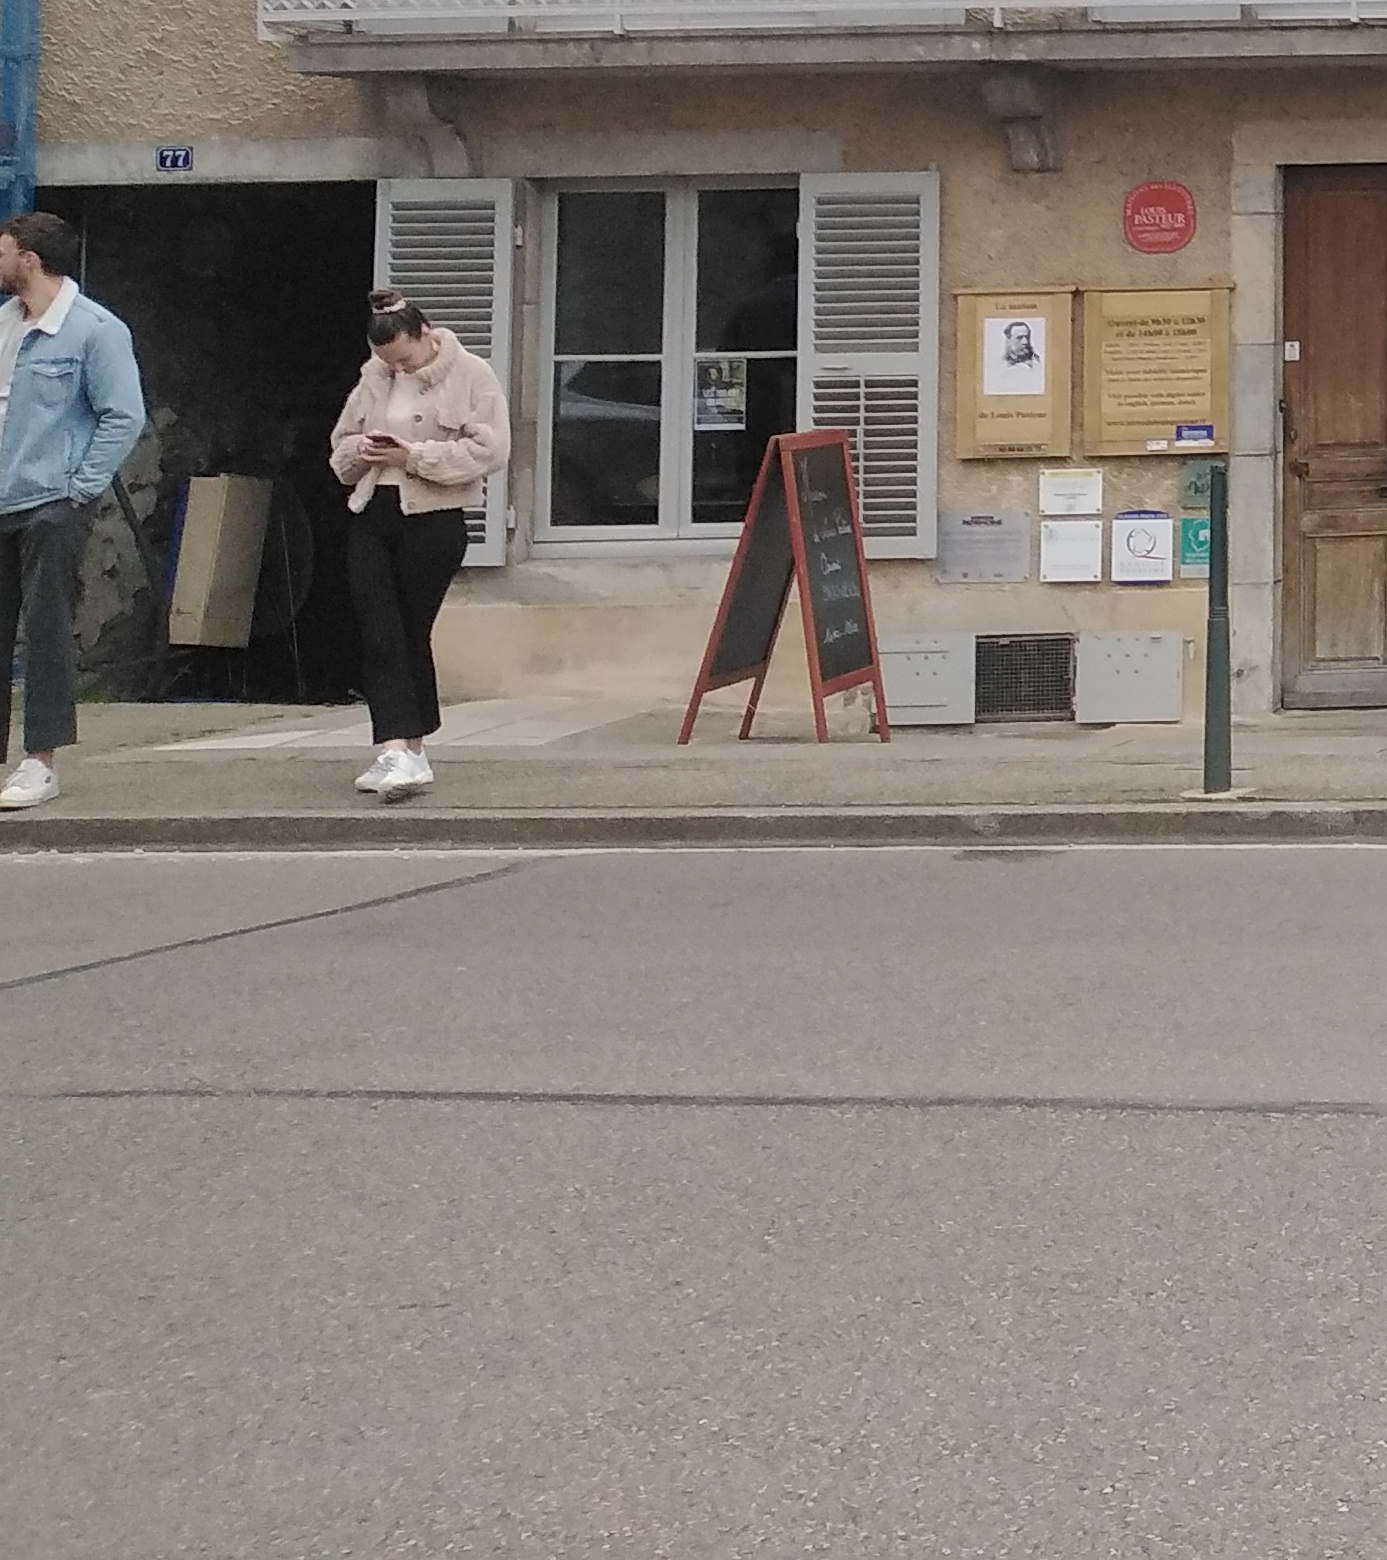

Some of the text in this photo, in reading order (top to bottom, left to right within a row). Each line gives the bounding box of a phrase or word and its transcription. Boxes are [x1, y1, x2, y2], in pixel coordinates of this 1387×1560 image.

[162, 150, 187, 167] 77
[1140, 206, 1167, 216] LOUIS
[1134, 213, 1186, 224] PASTEUR
